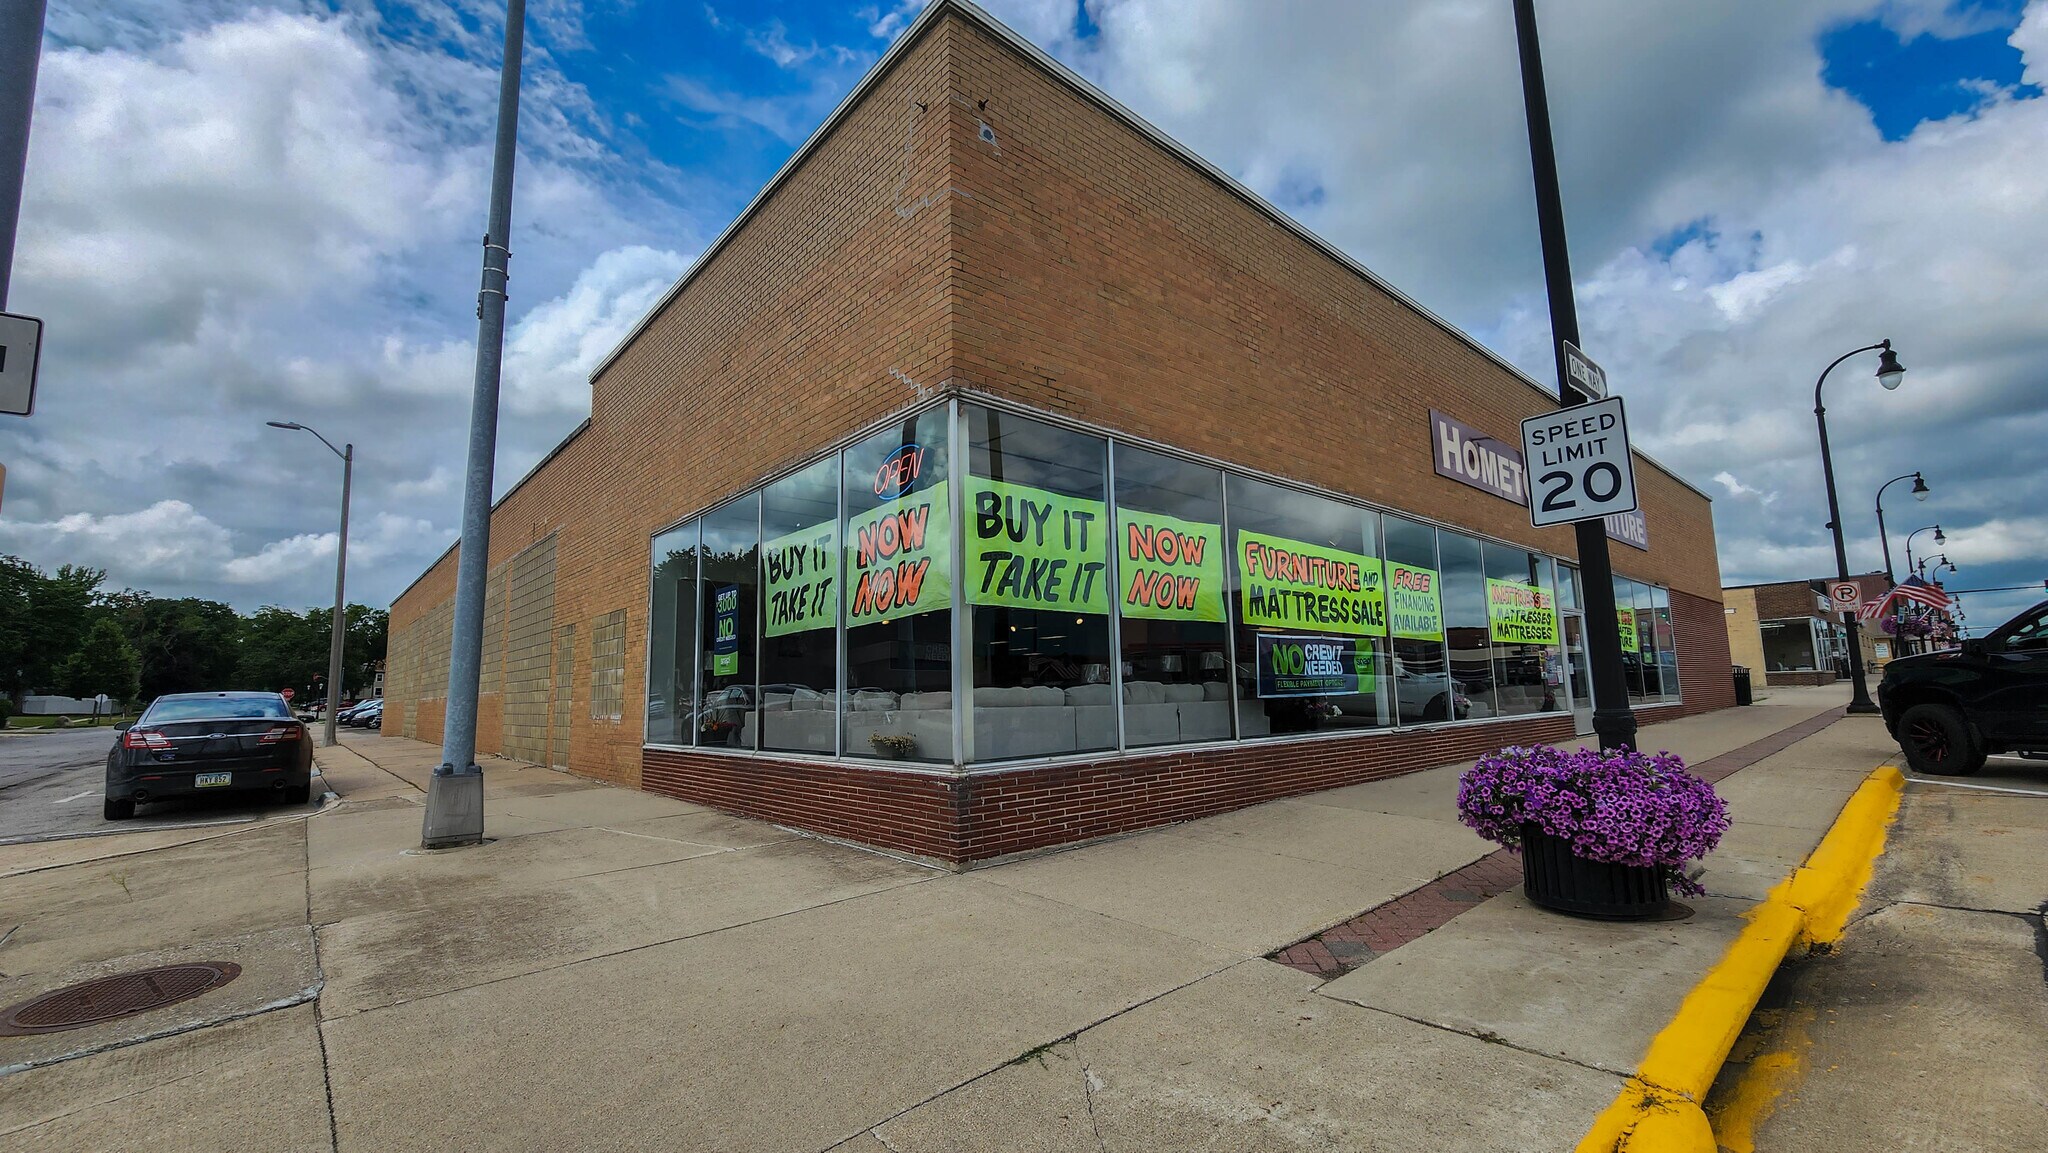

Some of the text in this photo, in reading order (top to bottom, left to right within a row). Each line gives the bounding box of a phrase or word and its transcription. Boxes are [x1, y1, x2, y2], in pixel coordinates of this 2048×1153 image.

[1571, 358, 1601, 393] ONE WAY
[1532, 413, 1616, 446] SPEED
[1439, 420, 1531, 499] HOMET
[1542, 437, 1608, 467] LIMIT
[874, 447, 924, 495] OPEN
[1538, 461, 1622, 513] 20
[857, 503, 930, 569] NOW
[976, 491, 1094, 552] BUY IT
[767, 534, 831, 585] BUY IT
[1127, 522, 1205, 567] NOW
[980, 551, 1105, 603] TAKE IT
[1245, 541, 1379, 592] FURNITURE AND
[1393, 568, 1431, 593] FREE
[771, 577, 832, 626] TAKE IT
[852, 557, 929, 618] NOW
[1127, 569, 1200, 610] NOW
[1249, 584, 1384, 626] MATTRESS SALE
[1394, 591, 1435, 613] FINANCING
[1491, 583, 1551, 610] MATTRESSES
[718, 617, 734, 638] NO
[1394, 613, 1438, 632] AVAILABLE
[1496, 608, 1552, 625] MATTRESSES
[1496, 622, 1553, 640] MATTRESSES
[1272, 643, 1344, 675] NO CREDIT
[1304, 660, 1344, 675] NEEDED
[1277, 680, 1299, 688] FLEXIBLE
[1300, 680, 1323, 688] PAYMENT
[200, 775, 227, 785] HKY 852
